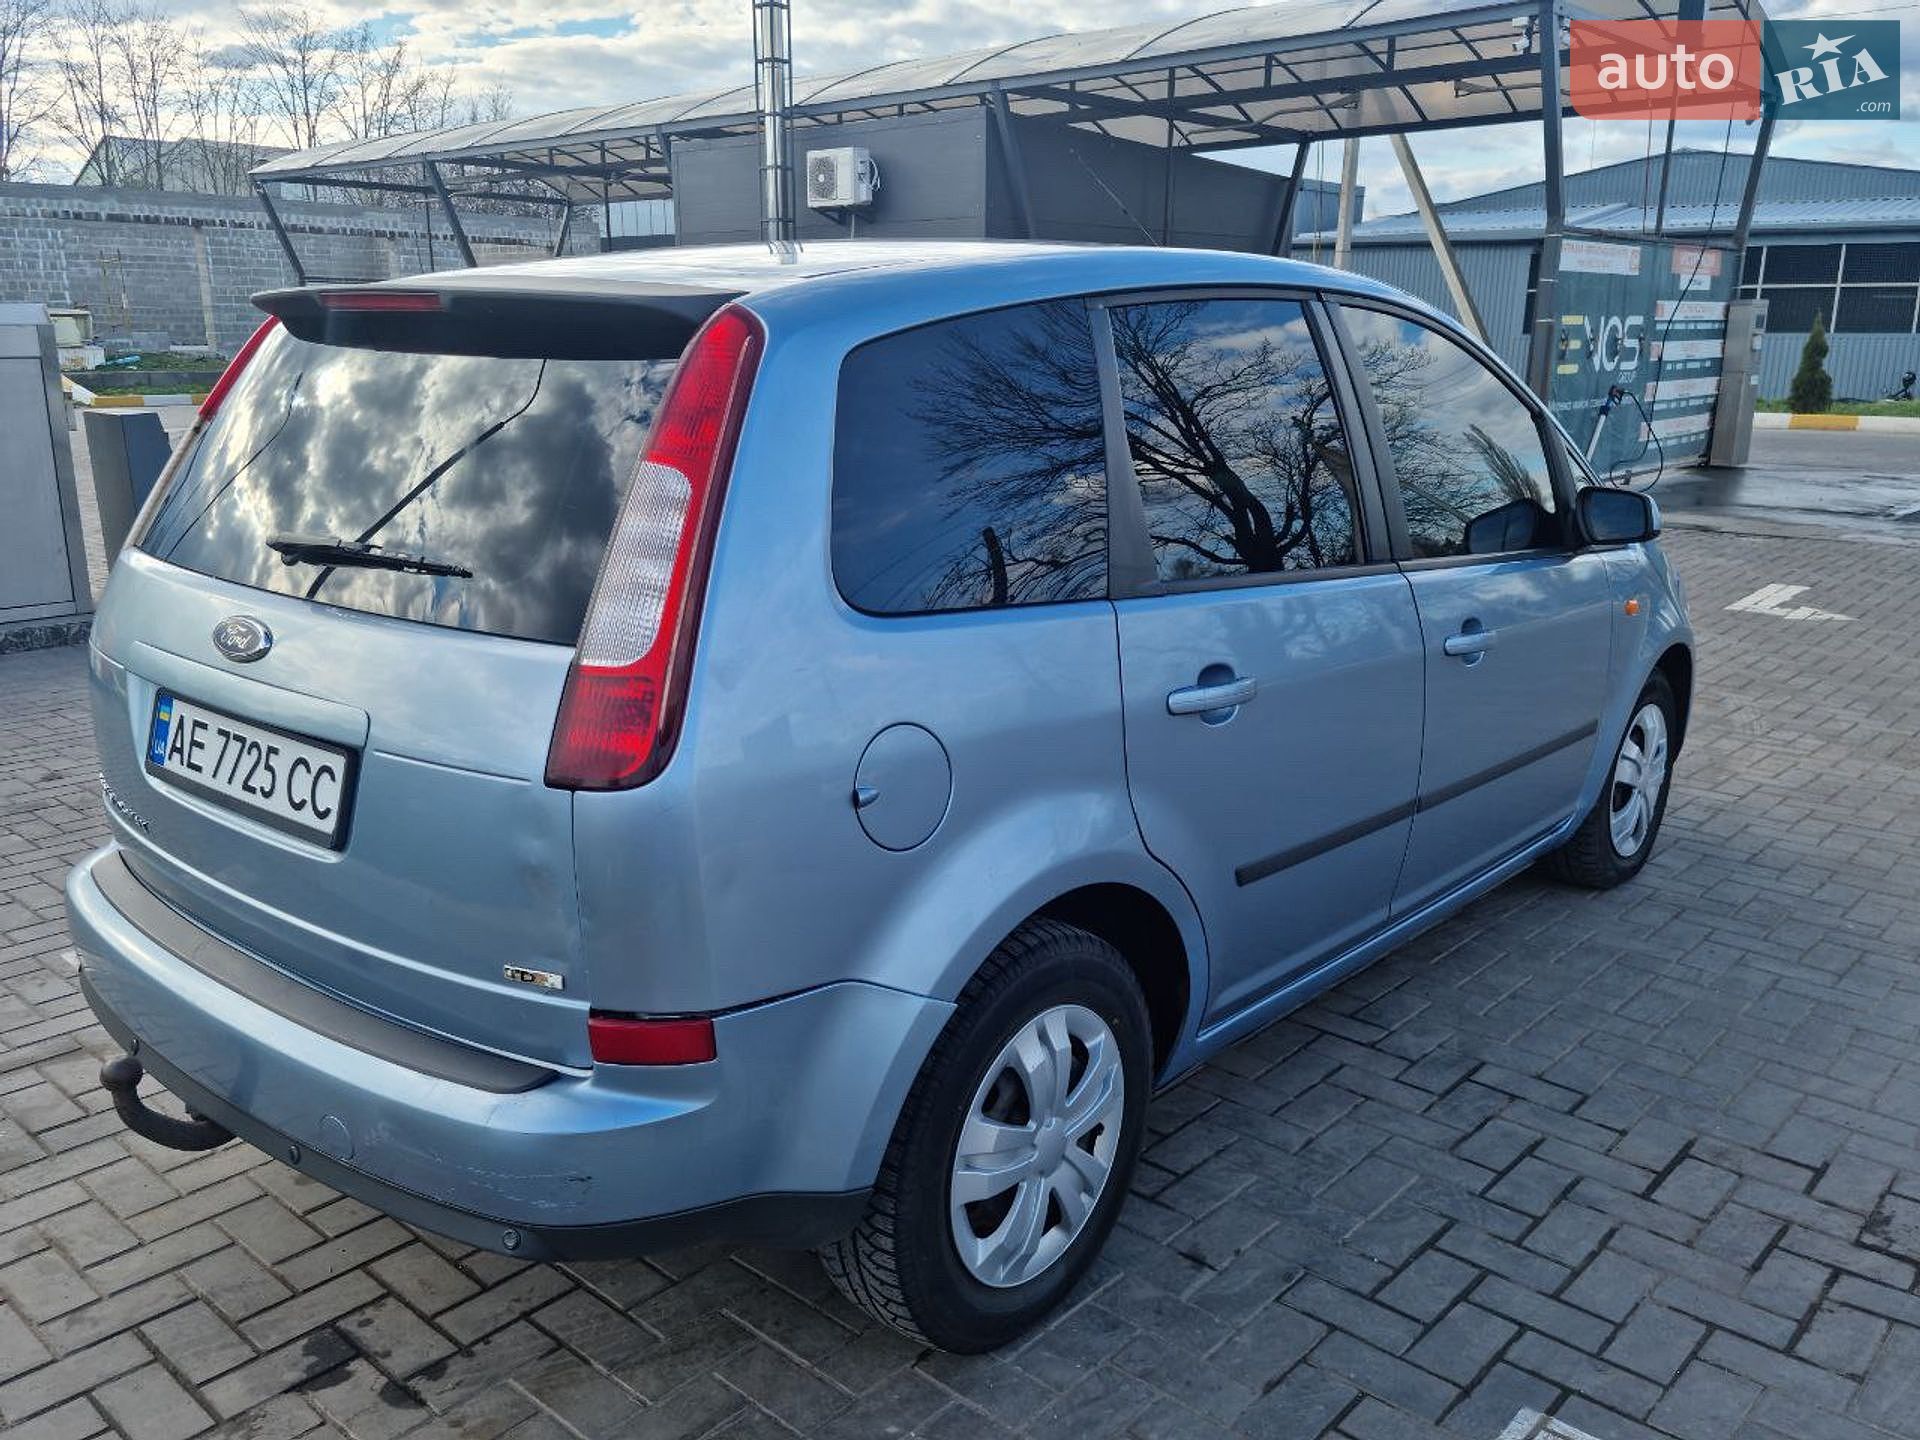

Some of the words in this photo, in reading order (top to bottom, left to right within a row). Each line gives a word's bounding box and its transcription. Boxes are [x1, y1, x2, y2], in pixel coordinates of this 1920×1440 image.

[168, 714, 208, 773] AE
[211, 727, 280, 799] 7725
[286, 757, 336, 820] CC
